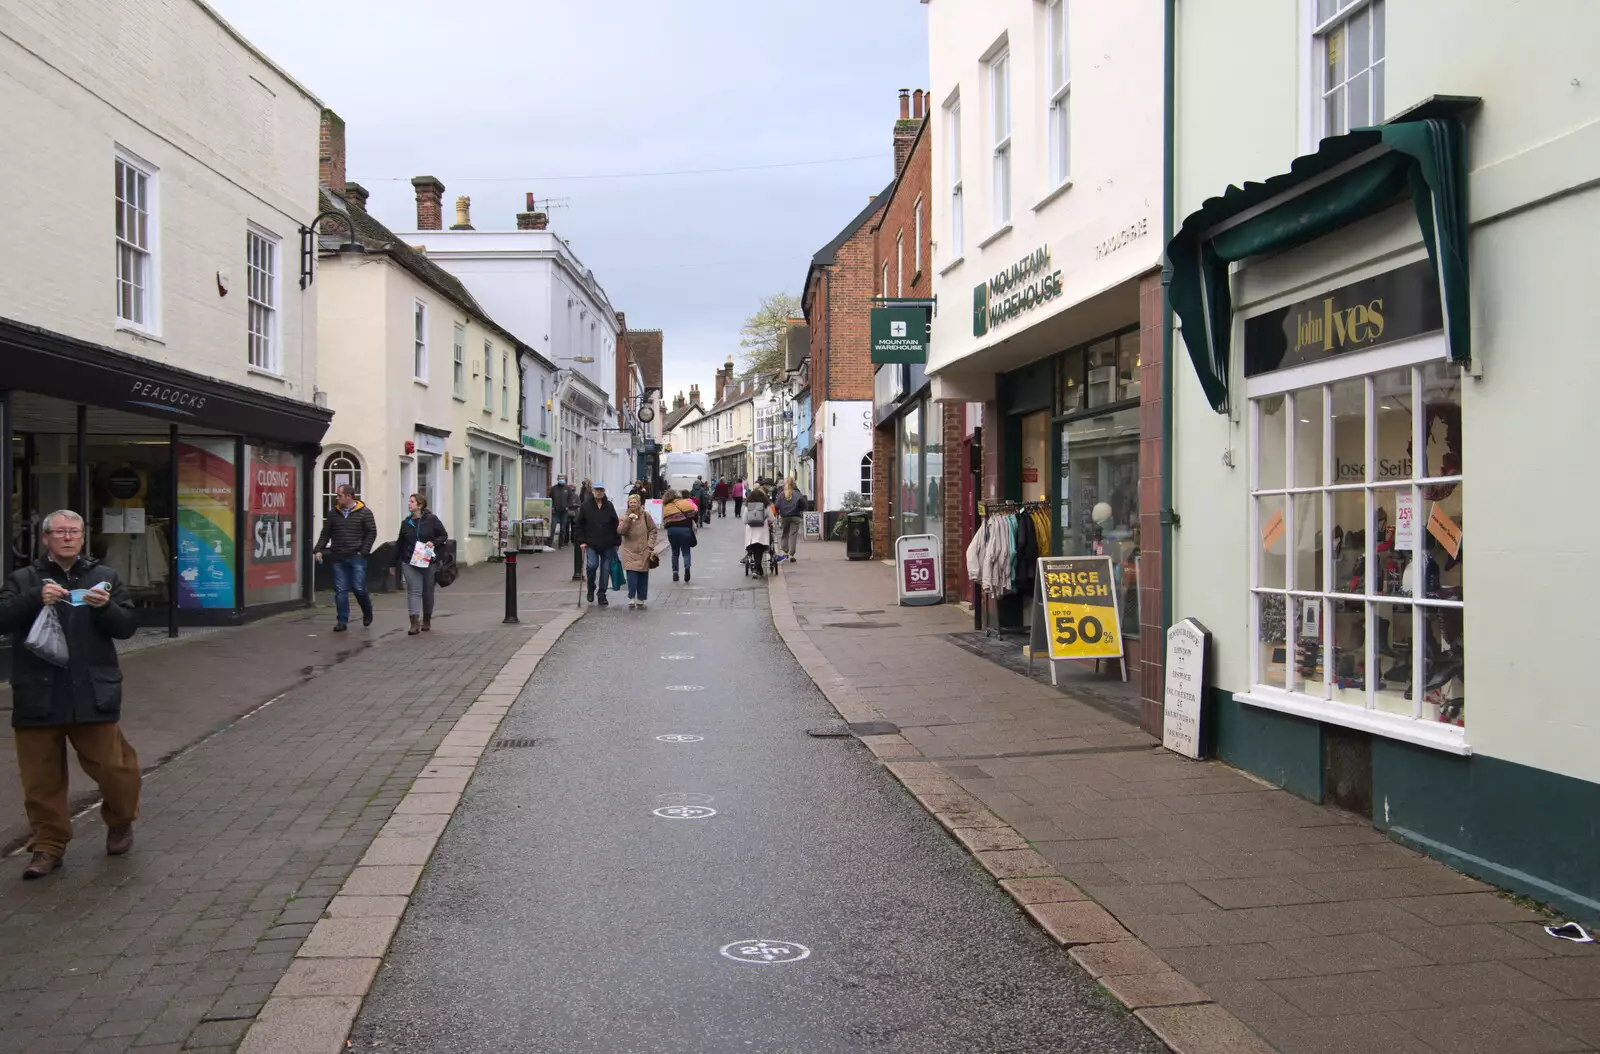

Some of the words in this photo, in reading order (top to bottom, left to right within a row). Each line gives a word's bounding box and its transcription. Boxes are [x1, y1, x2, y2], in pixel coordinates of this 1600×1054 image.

[989, 243, 1049, 300] MOUNTAIN
[989, 269, 1063, 330] WAREHOUSE
[1294, 310, 1322, 353] John
[1323, 296, 1384, 351] Ives
[131, 381, 206, 409] PEACOCKS
[257, 469, 289, 488] CLOSING
[1336, 458, 1376, 481] Jose
[261, 492, 286, 508] DOWN
[254, 520, 292, 558] SALE
[910, 567, 929, 581] 50
[1047, 571, 1100, 584] PRICE
[1049, 584, 1108, 598] CRASH
[740, 946, 790, 955] 2m
